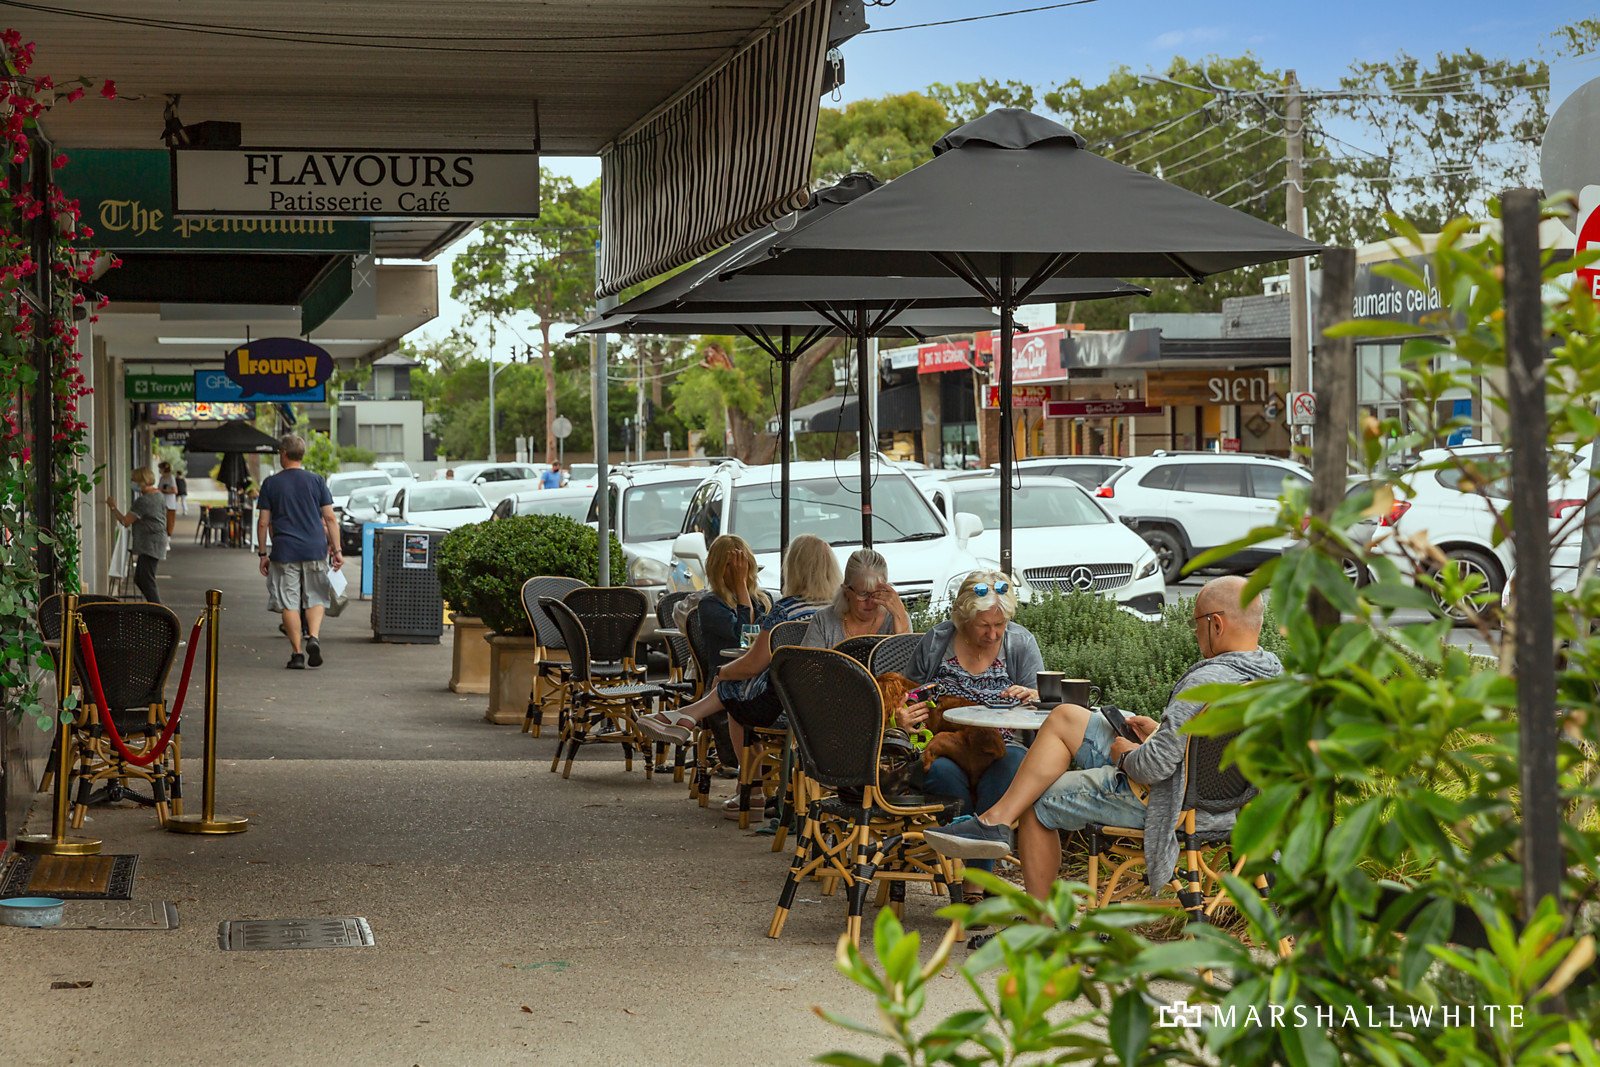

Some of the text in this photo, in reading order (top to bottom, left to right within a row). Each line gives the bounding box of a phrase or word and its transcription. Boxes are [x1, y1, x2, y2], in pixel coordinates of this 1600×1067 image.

[243, 153, 474, 188] FLAVOURS
[98, 199, 164, 237] The
[269, 191, 451, 212] Patisserie Café
[1353, 285, 1402, 318] aumaris
[150, 382, 194, 395] TerryW
